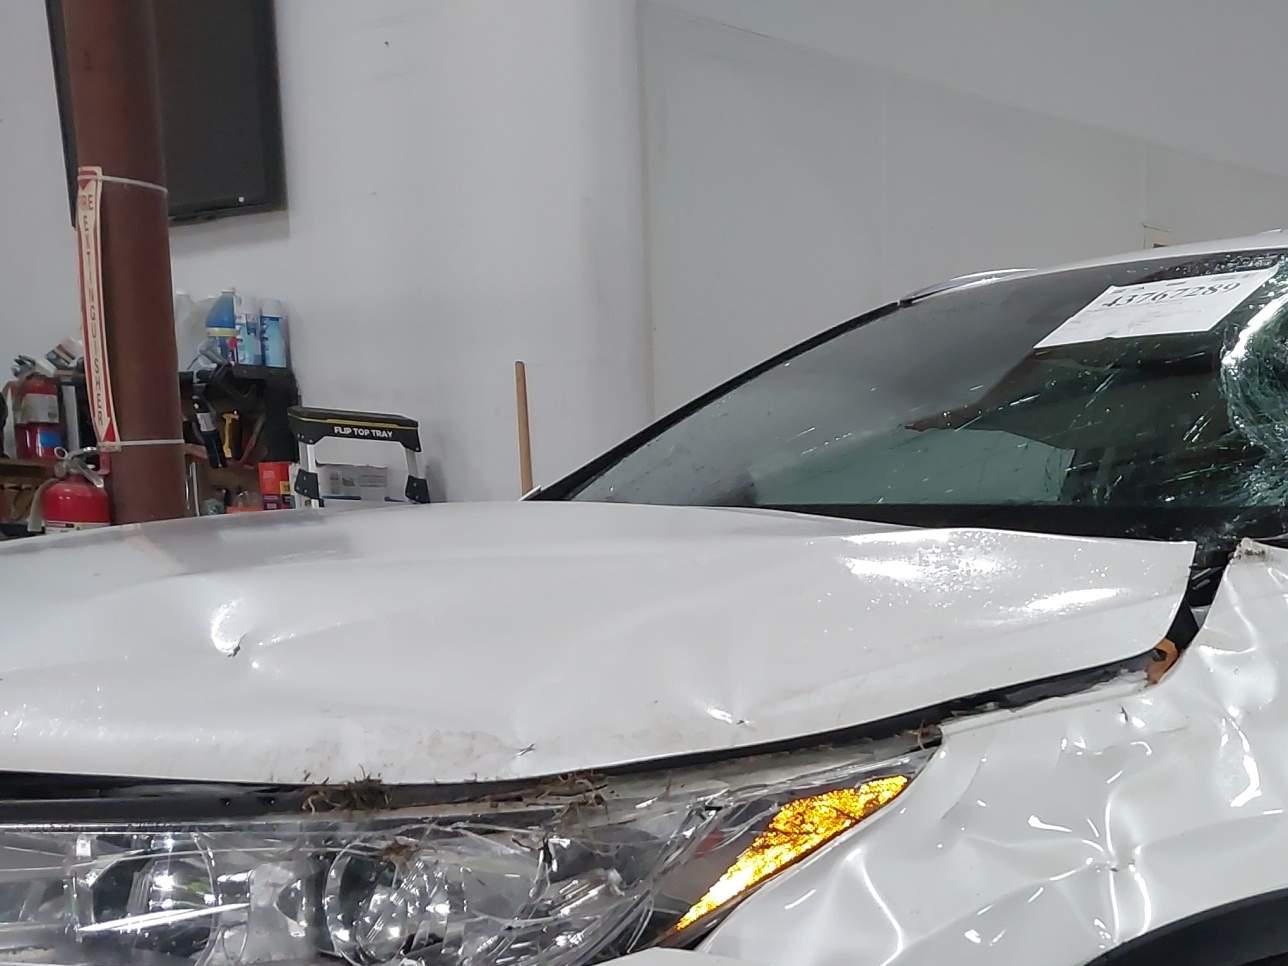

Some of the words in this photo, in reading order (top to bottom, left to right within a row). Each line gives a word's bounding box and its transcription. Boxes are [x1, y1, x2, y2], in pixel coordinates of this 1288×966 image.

[1101, 282, 1241, 307] 43767289
[334, 426, 352, 435] FLIP
[353, 427, 370, 436] TOP
[372, 429, 393, 438] TRAY
